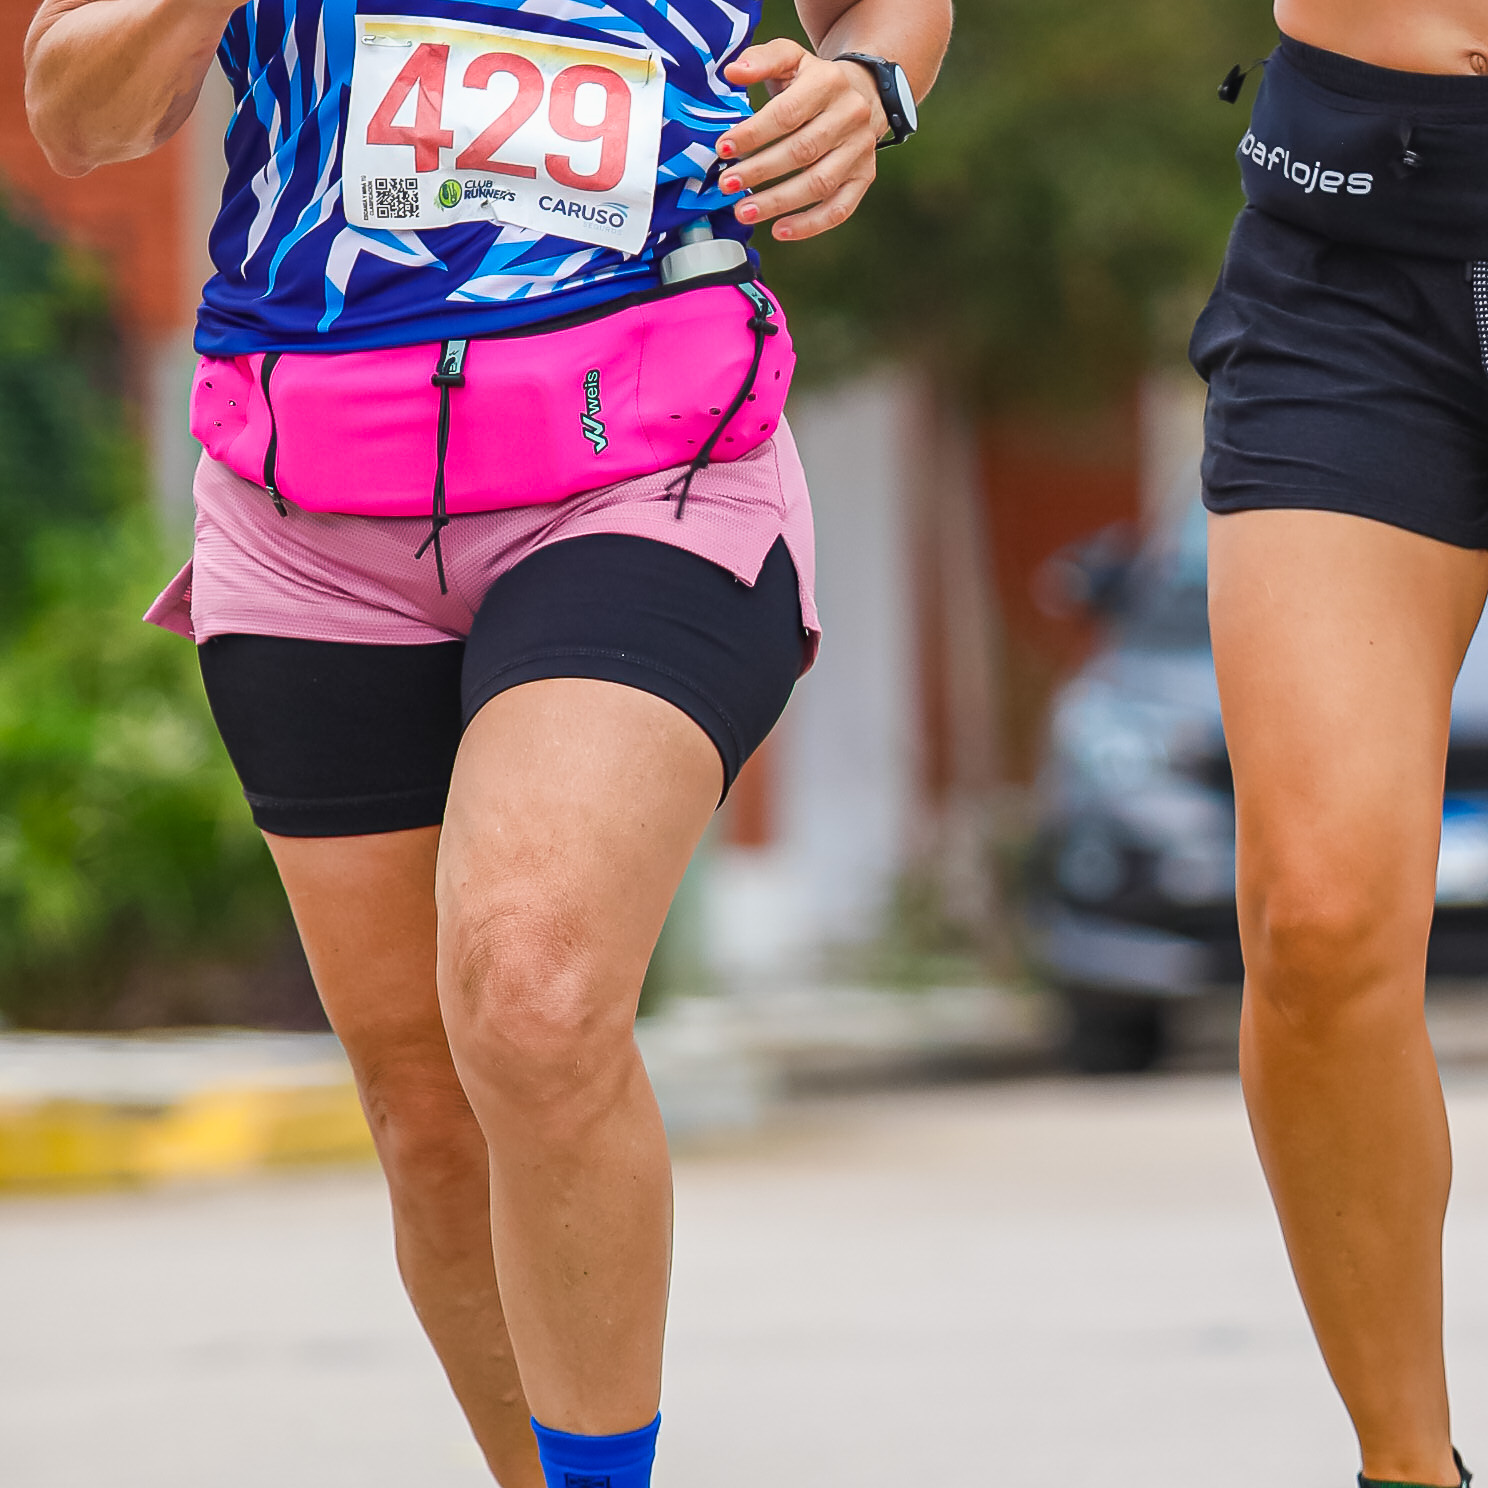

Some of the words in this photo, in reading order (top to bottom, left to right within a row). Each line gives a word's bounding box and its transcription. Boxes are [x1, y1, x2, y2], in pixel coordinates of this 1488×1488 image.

[366, 43, 632, 192] 429
[464, 179, 493, 189] CLUB
[538, 195, 625, 228] CARUSO
